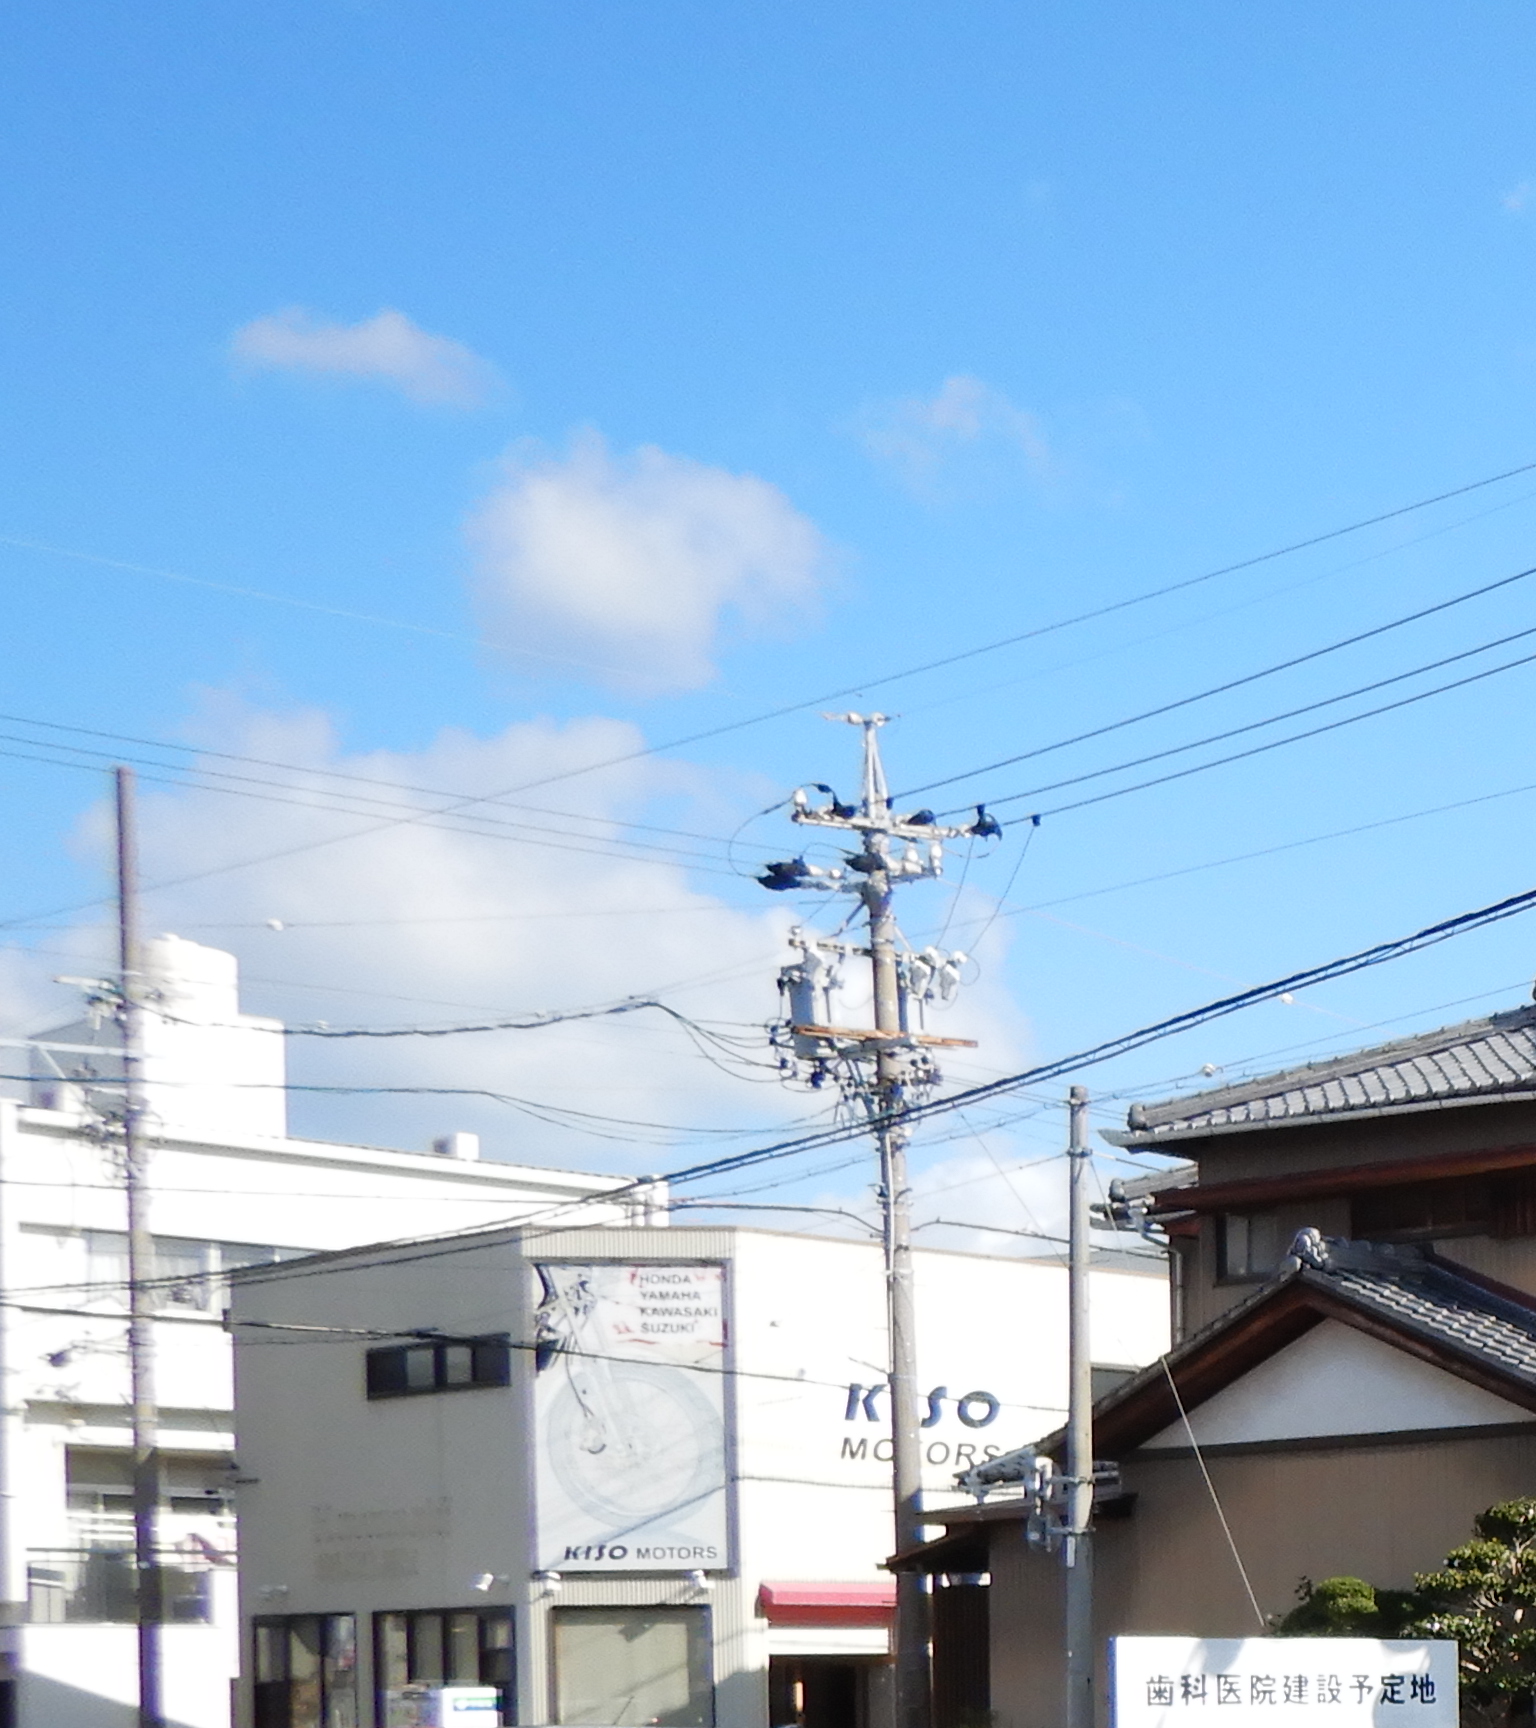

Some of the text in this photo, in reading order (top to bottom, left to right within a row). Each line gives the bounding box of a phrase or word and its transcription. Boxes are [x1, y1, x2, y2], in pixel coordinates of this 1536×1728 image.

[640, 1274, 692, 1285] HONDA
[640, 1291, 701, 1301] YAMAHA
[640, 1306, 718, 1317] KAWASAKI
[641, 1322, 695, 1333] SUZUKI
[845, 1383, 1000, 1428] KSO
[841, 1437, 1001, 1472] MOORS
[564, 1545, 718, 1561] KISO MOTORS
[1146, 1666, 1437, 1706] 歯科医院建設予定地
